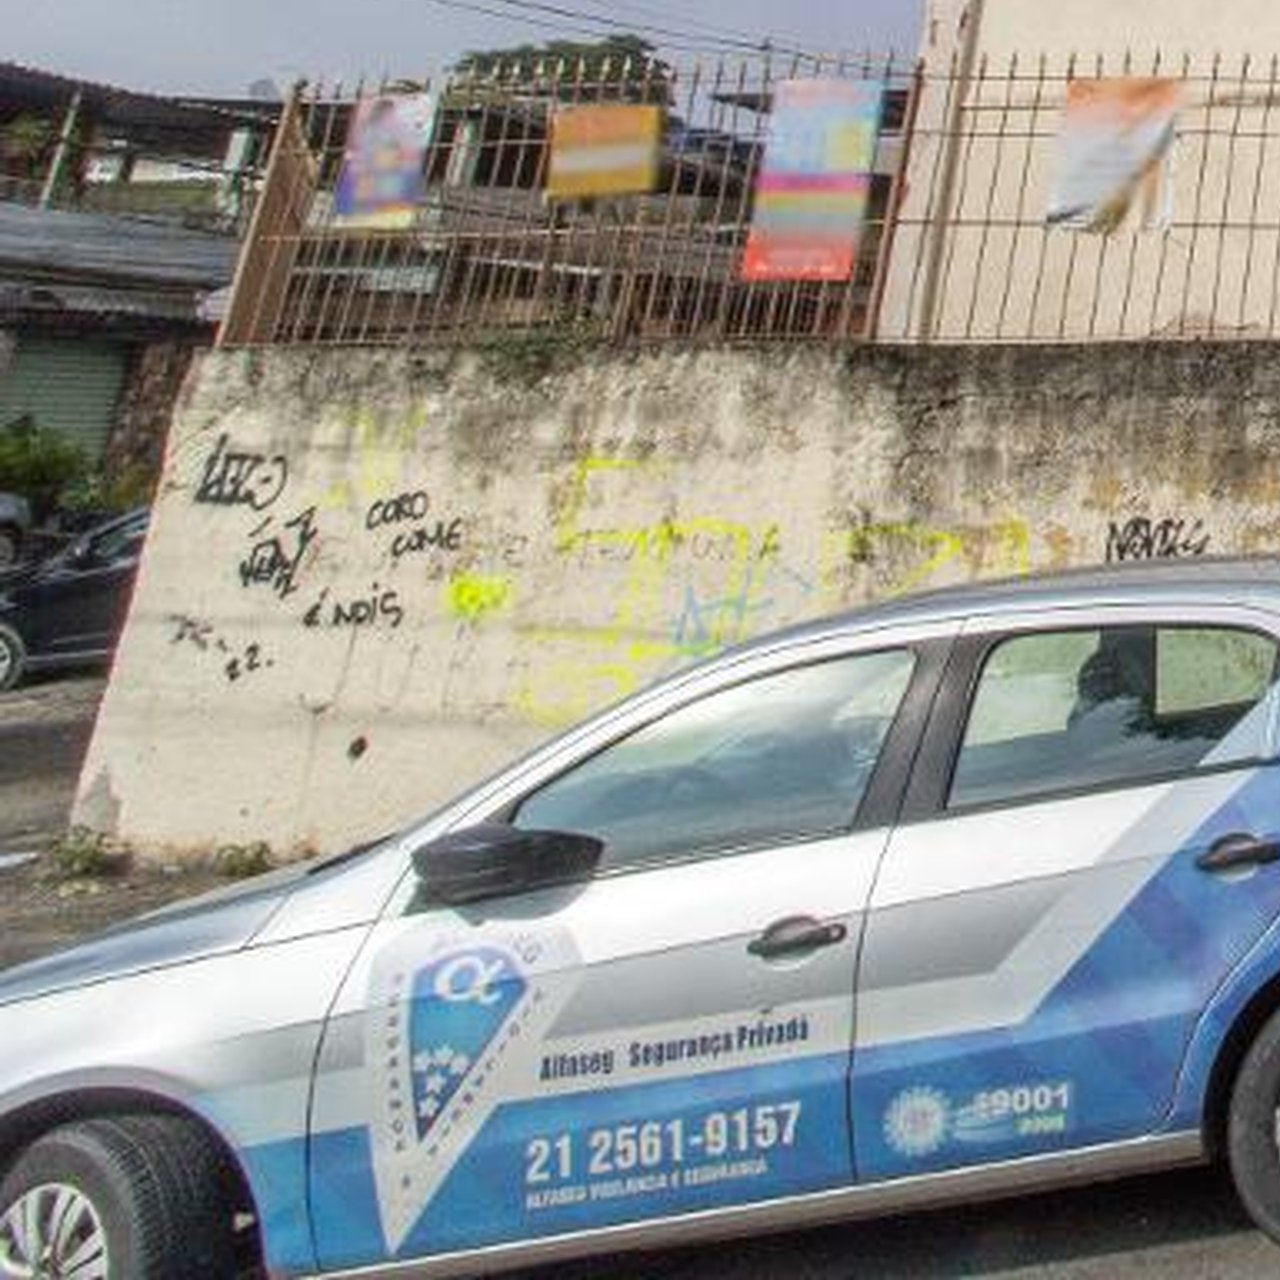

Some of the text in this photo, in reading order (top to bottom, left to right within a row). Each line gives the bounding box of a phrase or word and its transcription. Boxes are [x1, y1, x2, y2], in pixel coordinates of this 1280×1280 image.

[540, 1015, 809, 1082] Alfaseg Segurança Privada
[526, 1100, 801, 1183] 21 2561-9157
